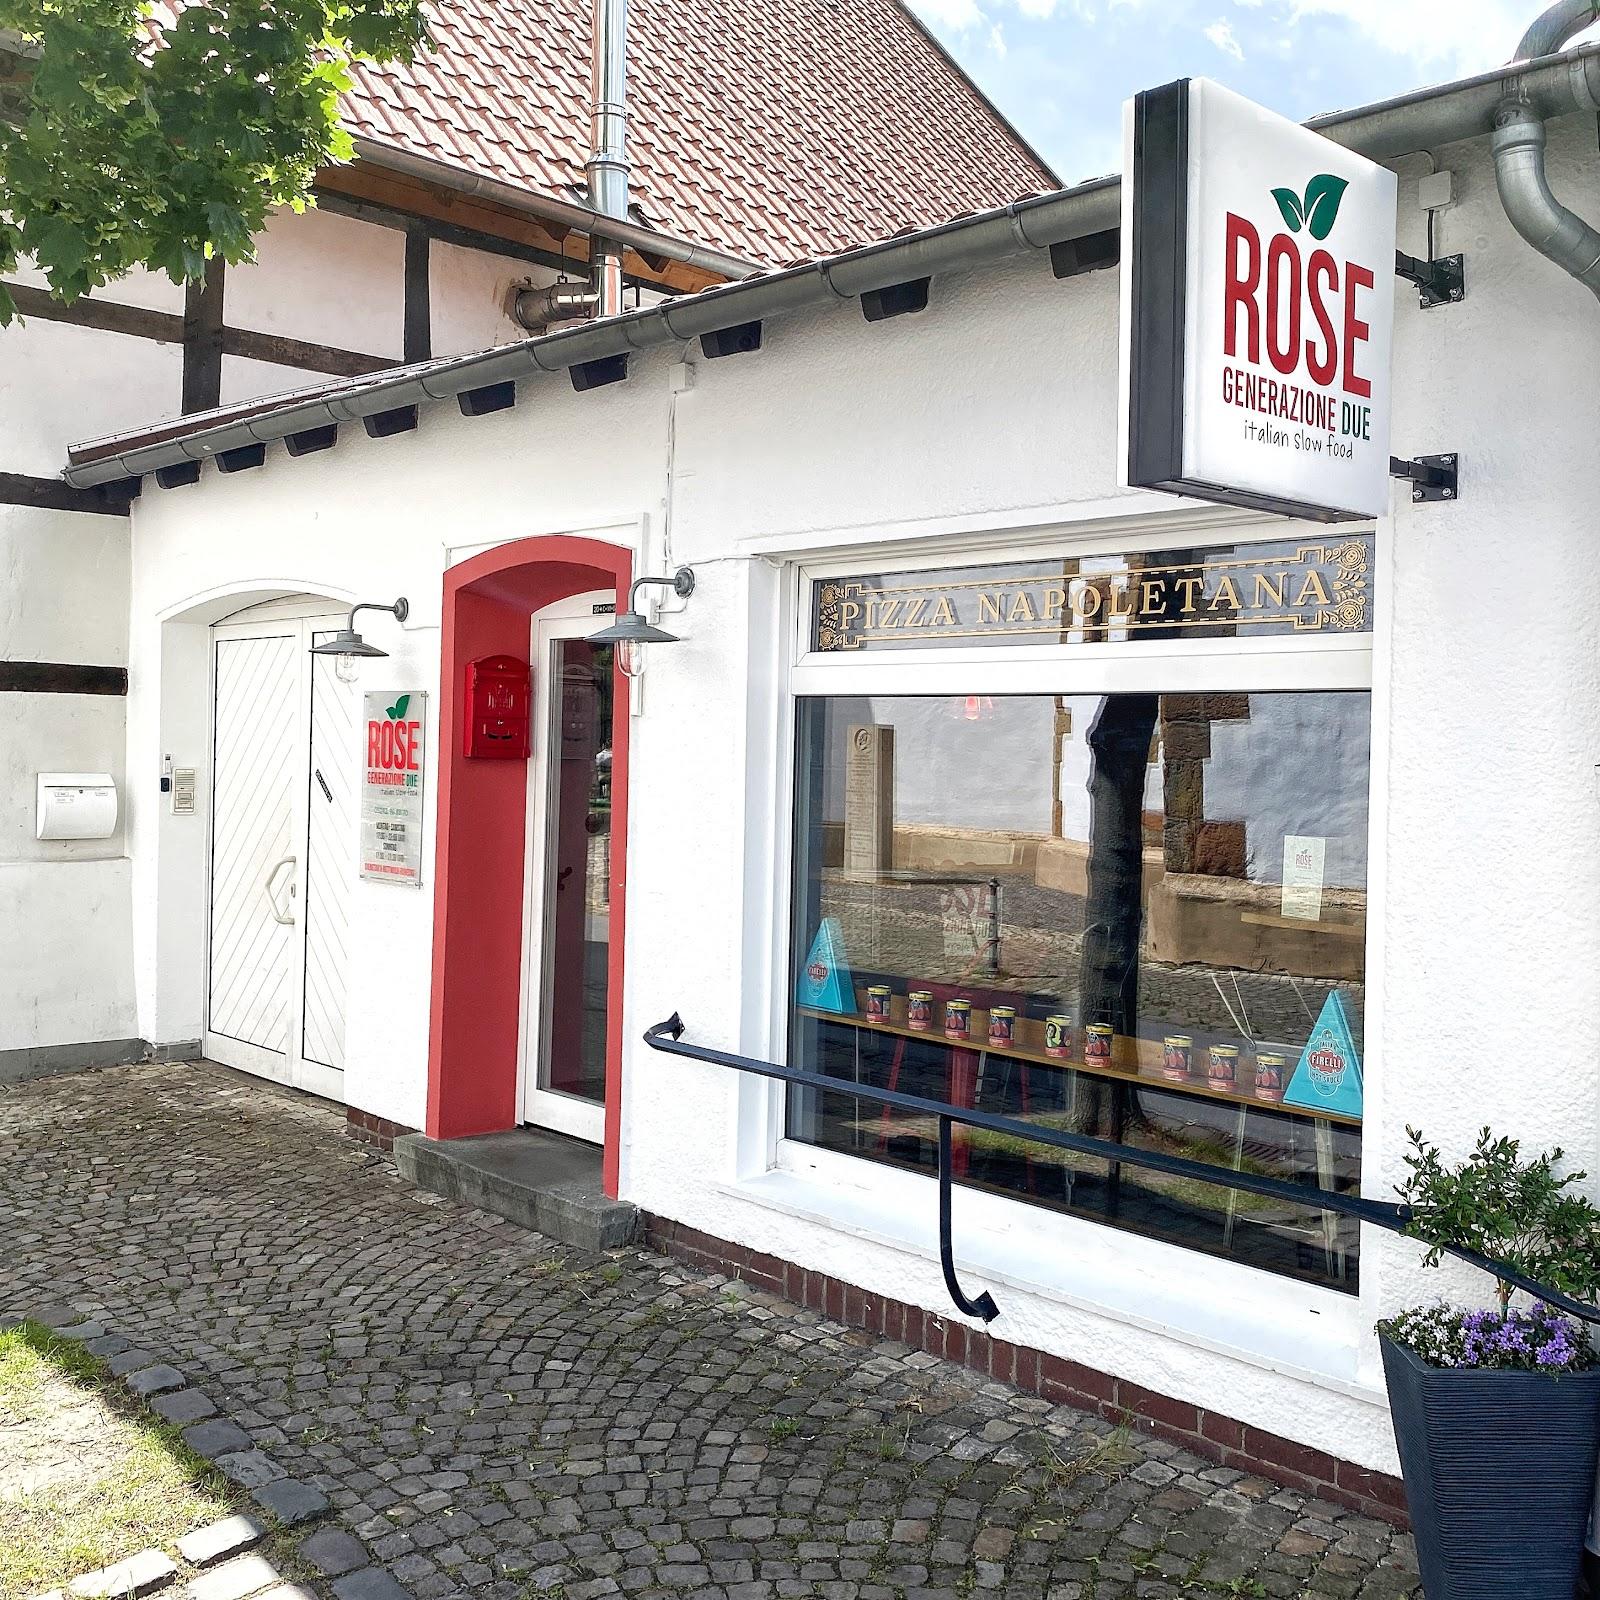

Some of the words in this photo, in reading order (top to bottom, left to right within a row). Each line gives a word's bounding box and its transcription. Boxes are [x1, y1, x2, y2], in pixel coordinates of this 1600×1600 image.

[1223, 211, 1374, 398] ROSE
[1222, 366, 1336, 433] GENERAZIONE
[1340, 405, 1371, 442] DUE
[1244, 418, 1289, 448] italian
[1293, 428, 1323, 453] slow
[1325, 433, 1354, 460] food
[840, 595, 955, 631] PIZZA
[976, 569, 1334, 624] NAPOLETANA
[367, 720, 420, 770] ROSE
[406, 774, 418, 787] DUE
[1296, 854, 1312, 866] ROSE
[1311, 1055, 1340, 1068] FIRELLI
